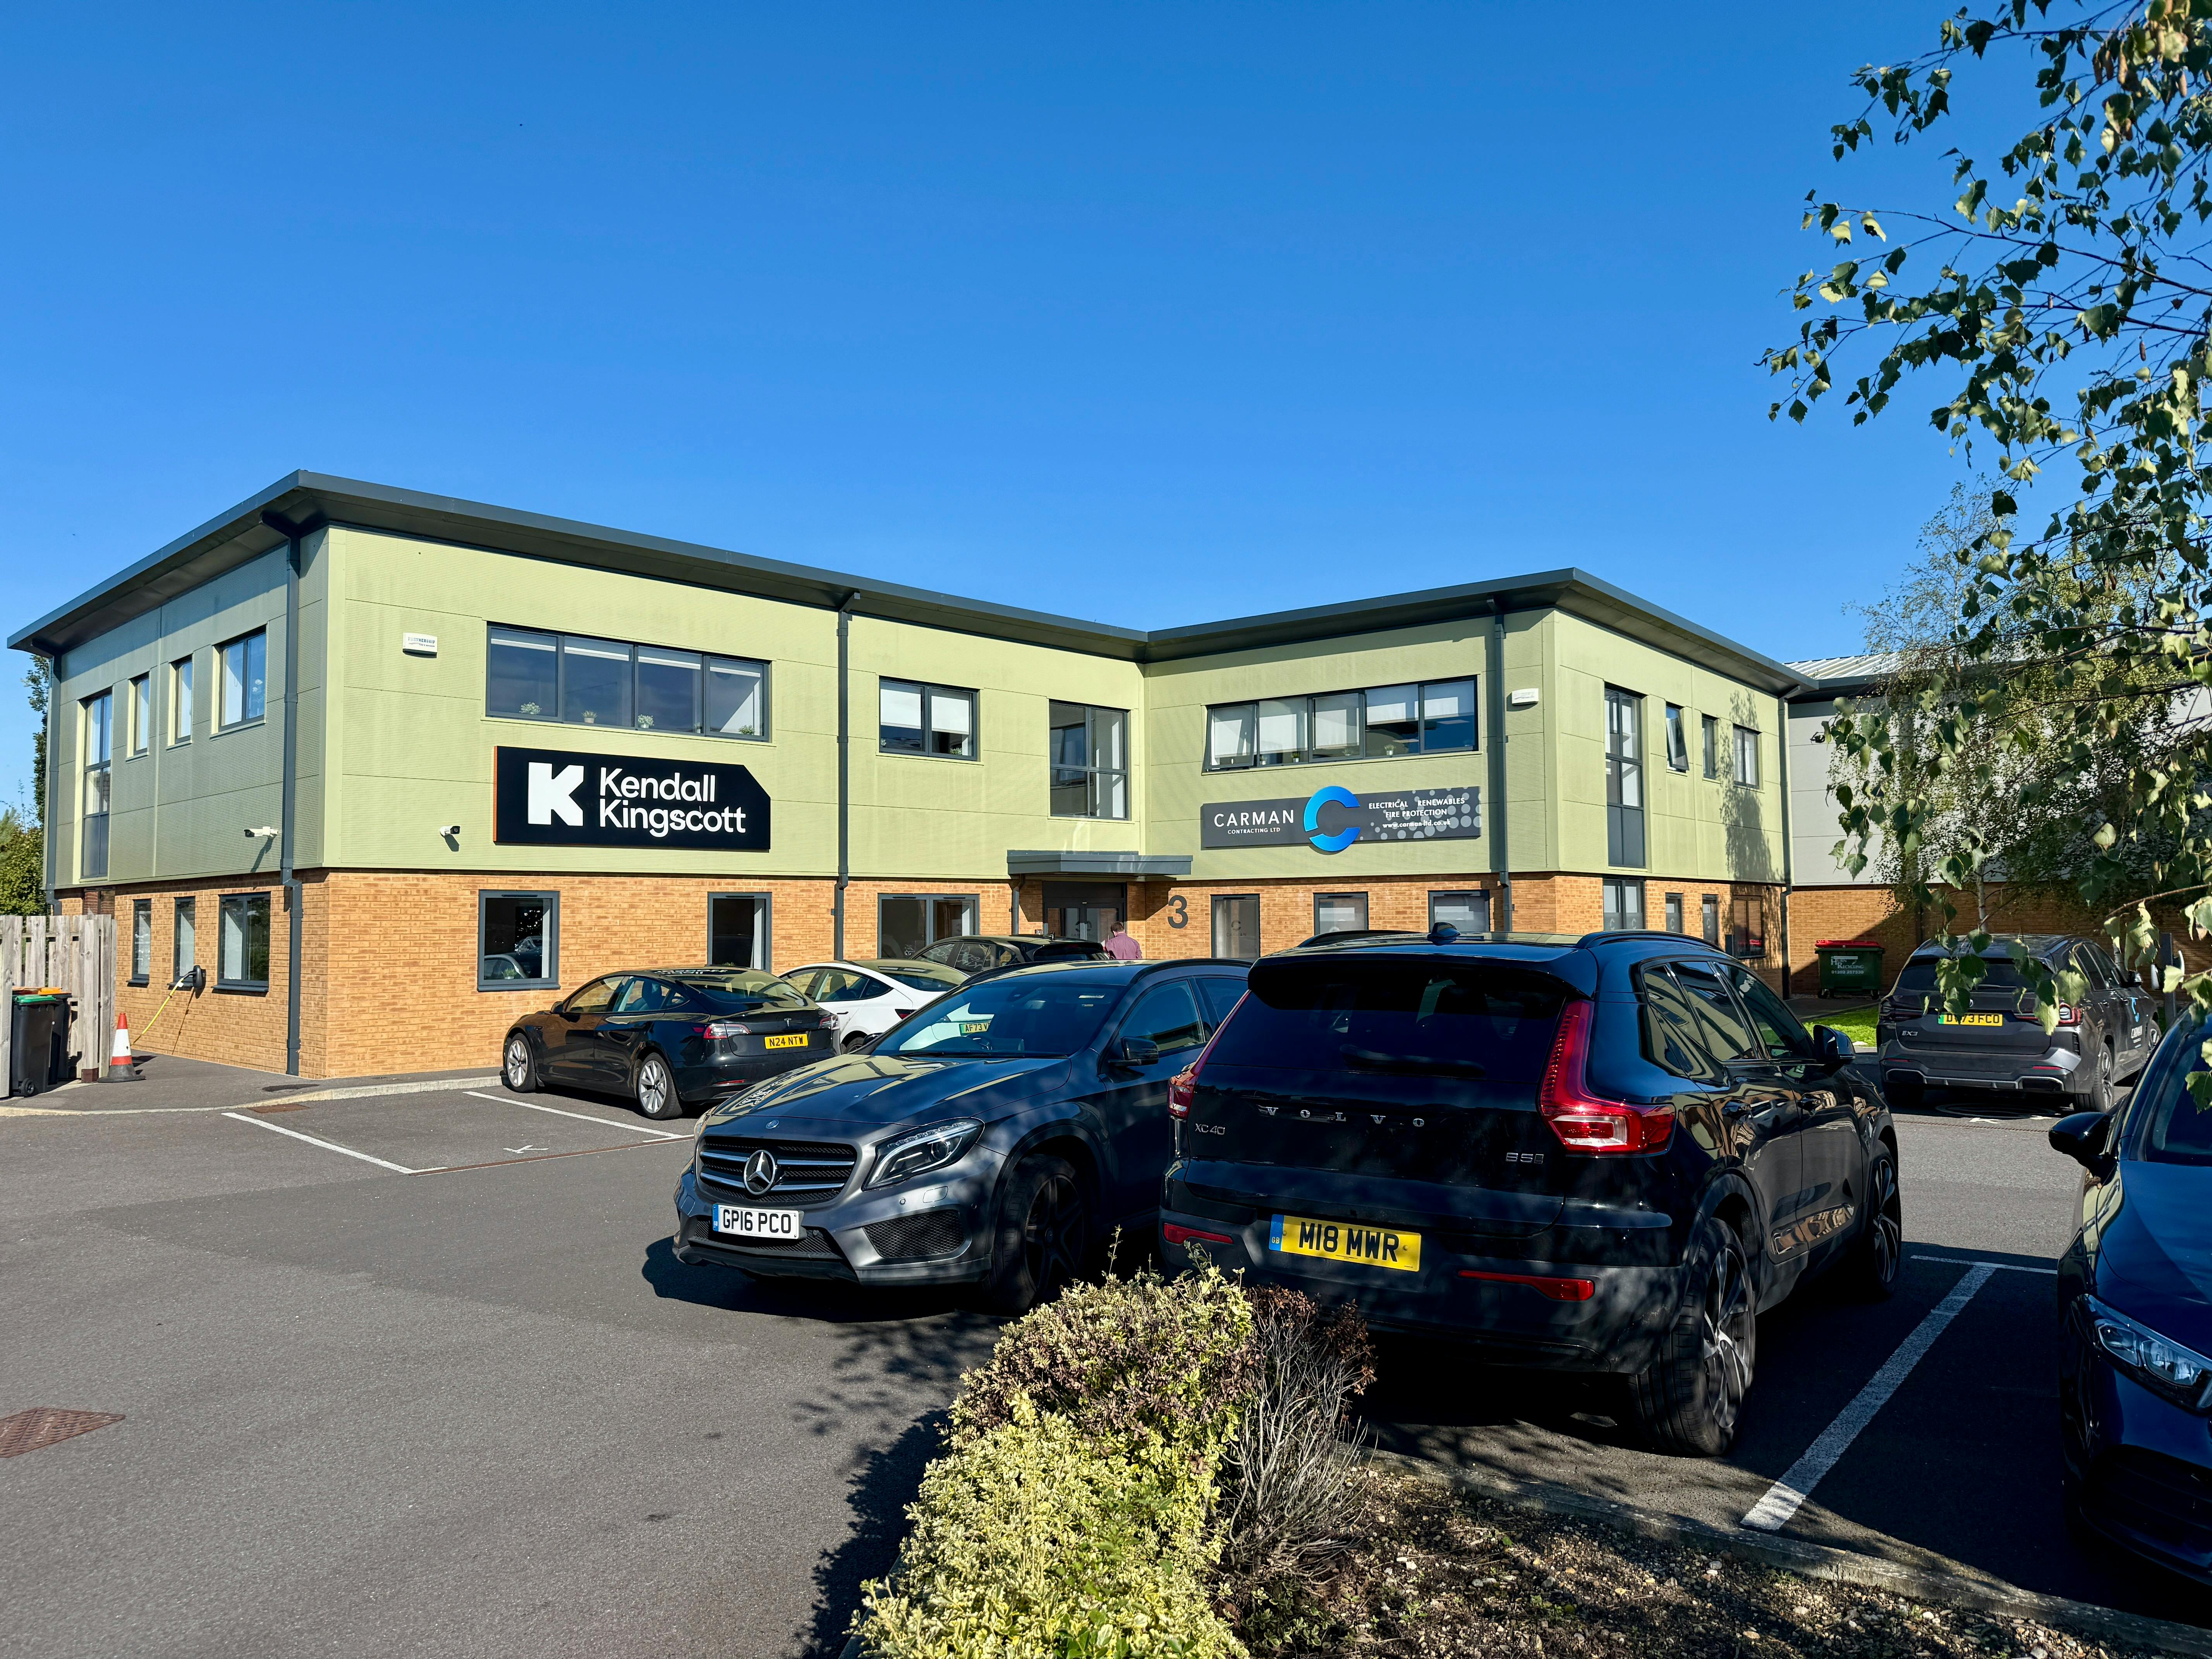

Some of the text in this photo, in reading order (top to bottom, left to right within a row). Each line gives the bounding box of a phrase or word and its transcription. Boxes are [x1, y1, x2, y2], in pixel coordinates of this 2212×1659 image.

[600, 766, 716, 802] Kendall
[1369, 797, 1465, 810] ELECTRICAL RENEWABLES
[599, 799, 746, 838] Kingscott
[1214, 809, 1294, 828] CARMAN
[1402, 809, 1447, 817] PROTECTION
[1382, 818, 1451, 828] www.carman-ltd.co.uk
[1167, 895, 1188, 929] 3
[1947, 1013, 2000, 1024] D73 FCO
[769, 1036, 803, 1046] N24 NTW
[1266, 1106, 1425, 1128] VOLVO
[1195, 1123, 1226, 1135] XC40
[723, 1209, 791, 1234] GP16 PCO
[1271, 1236, 1280, 1244] GB
[1298, 1221, 1400, 1262] M18 MWR
